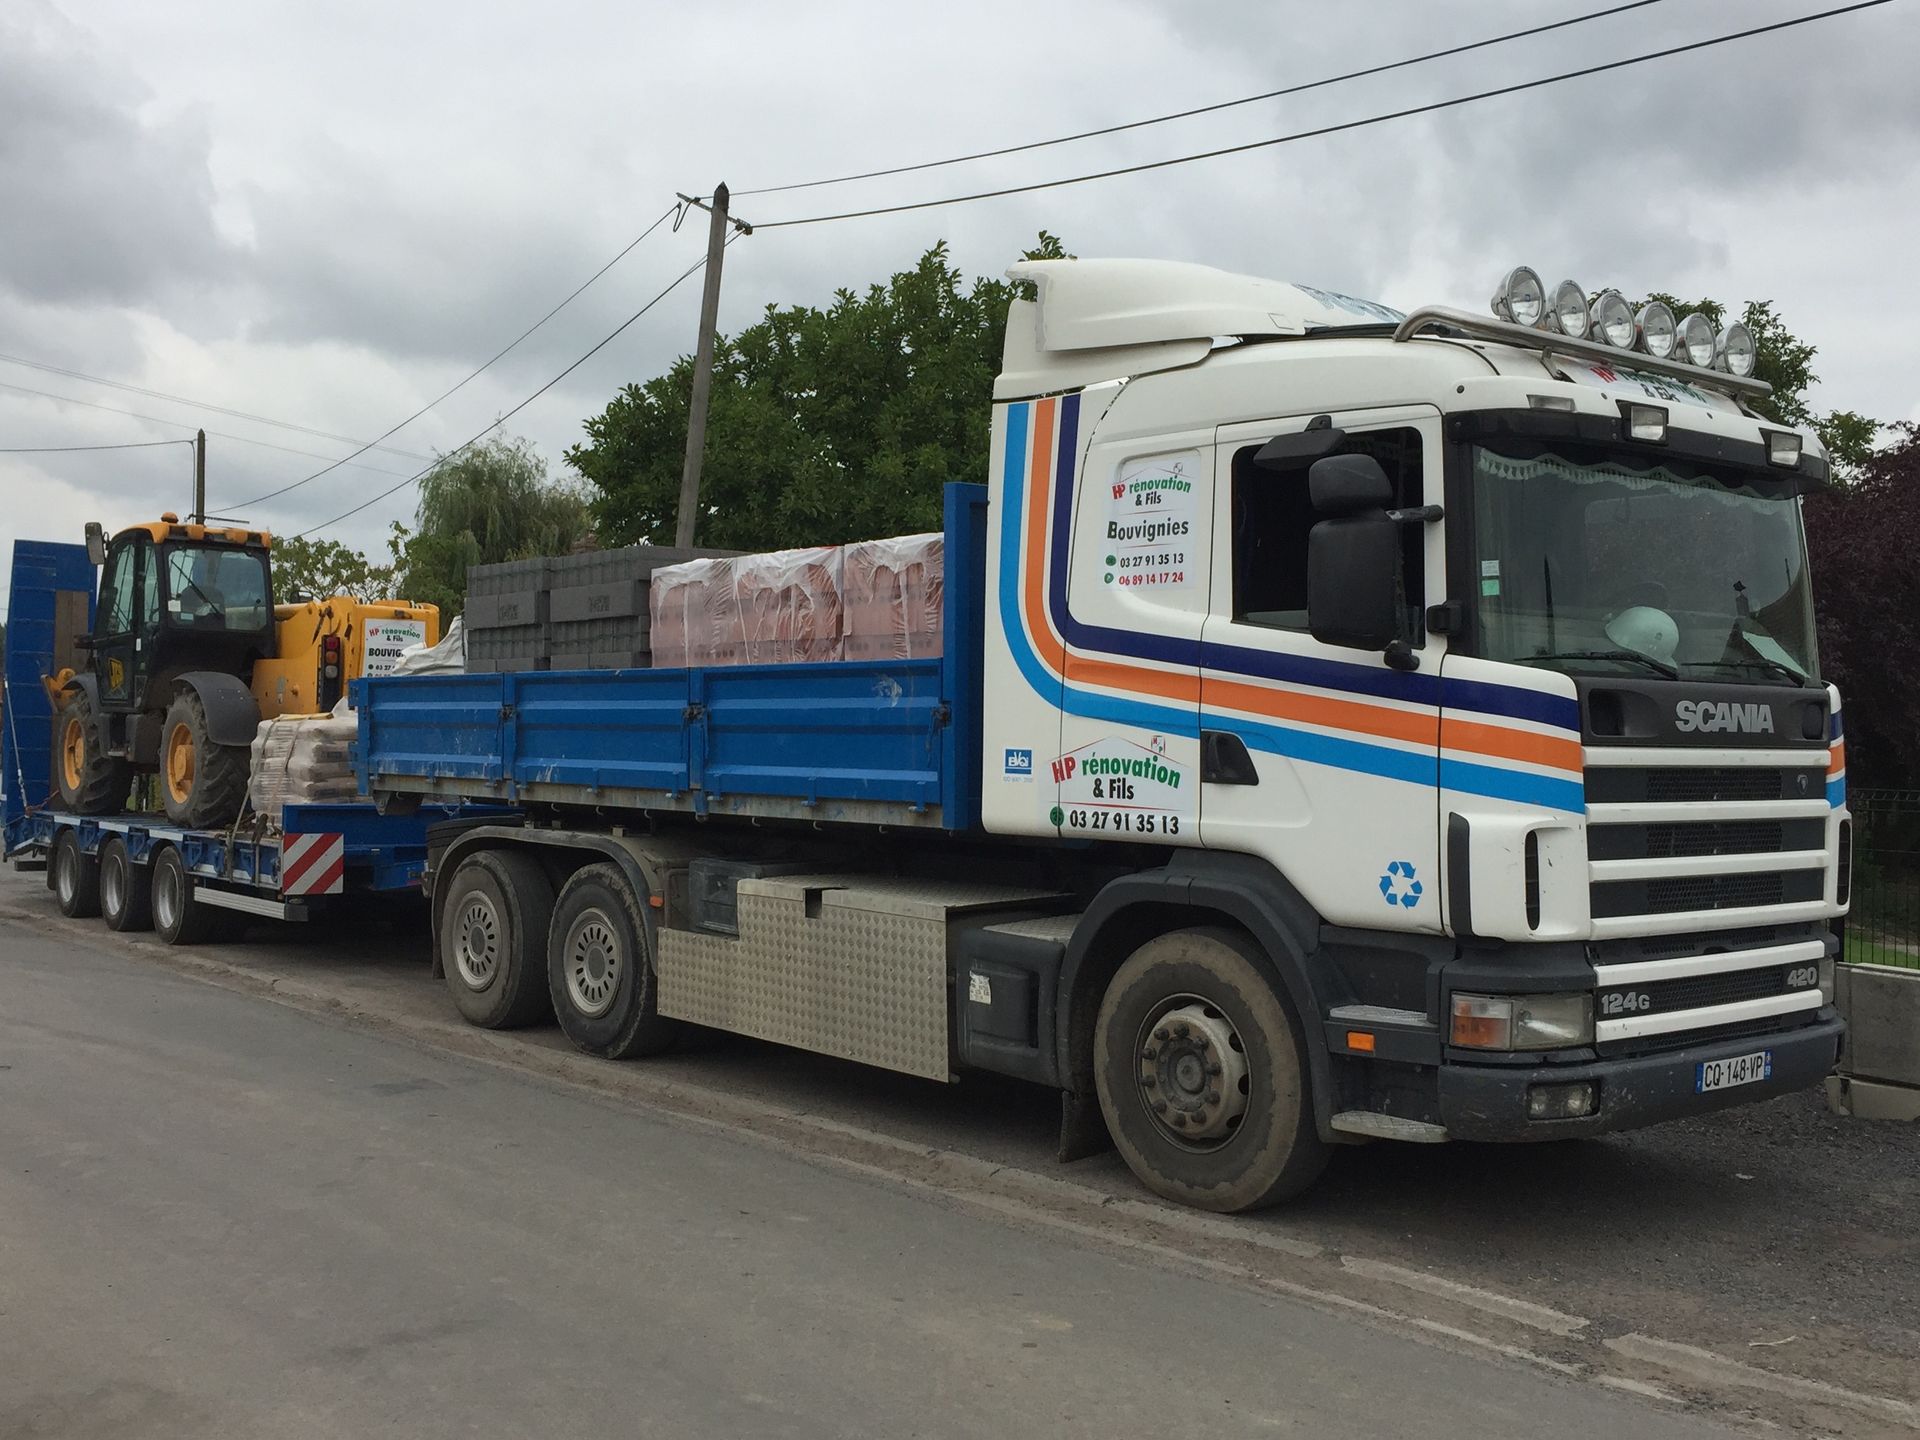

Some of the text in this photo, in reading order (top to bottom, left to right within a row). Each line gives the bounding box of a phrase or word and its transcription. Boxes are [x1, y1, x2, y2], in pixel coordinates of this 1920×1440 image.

[1112, 475, 1192, 500] HP rénovation
[1135, 491, 1162, 506] & Fils
[1107, 517, 1189, 542] Bouvignies
[1120, 553, 1184, 568] 03 27 91 35 13
[1118, 571, 1184, 586] 06 89 14 17 24
[1675, 700, 1774, 733] SCANIA
[1051, 752, 1181, 789] HP rénovation
[1093, 776, 1135, 800] & Fils
[1069, 810, 1179, 835] 03 27 91 35 13
[1787, 967, 1817, 987] 420
[1601, 992, 1650, 1014] 124G
[1704, 1055, 1763, 1087] CQ-148-VP
